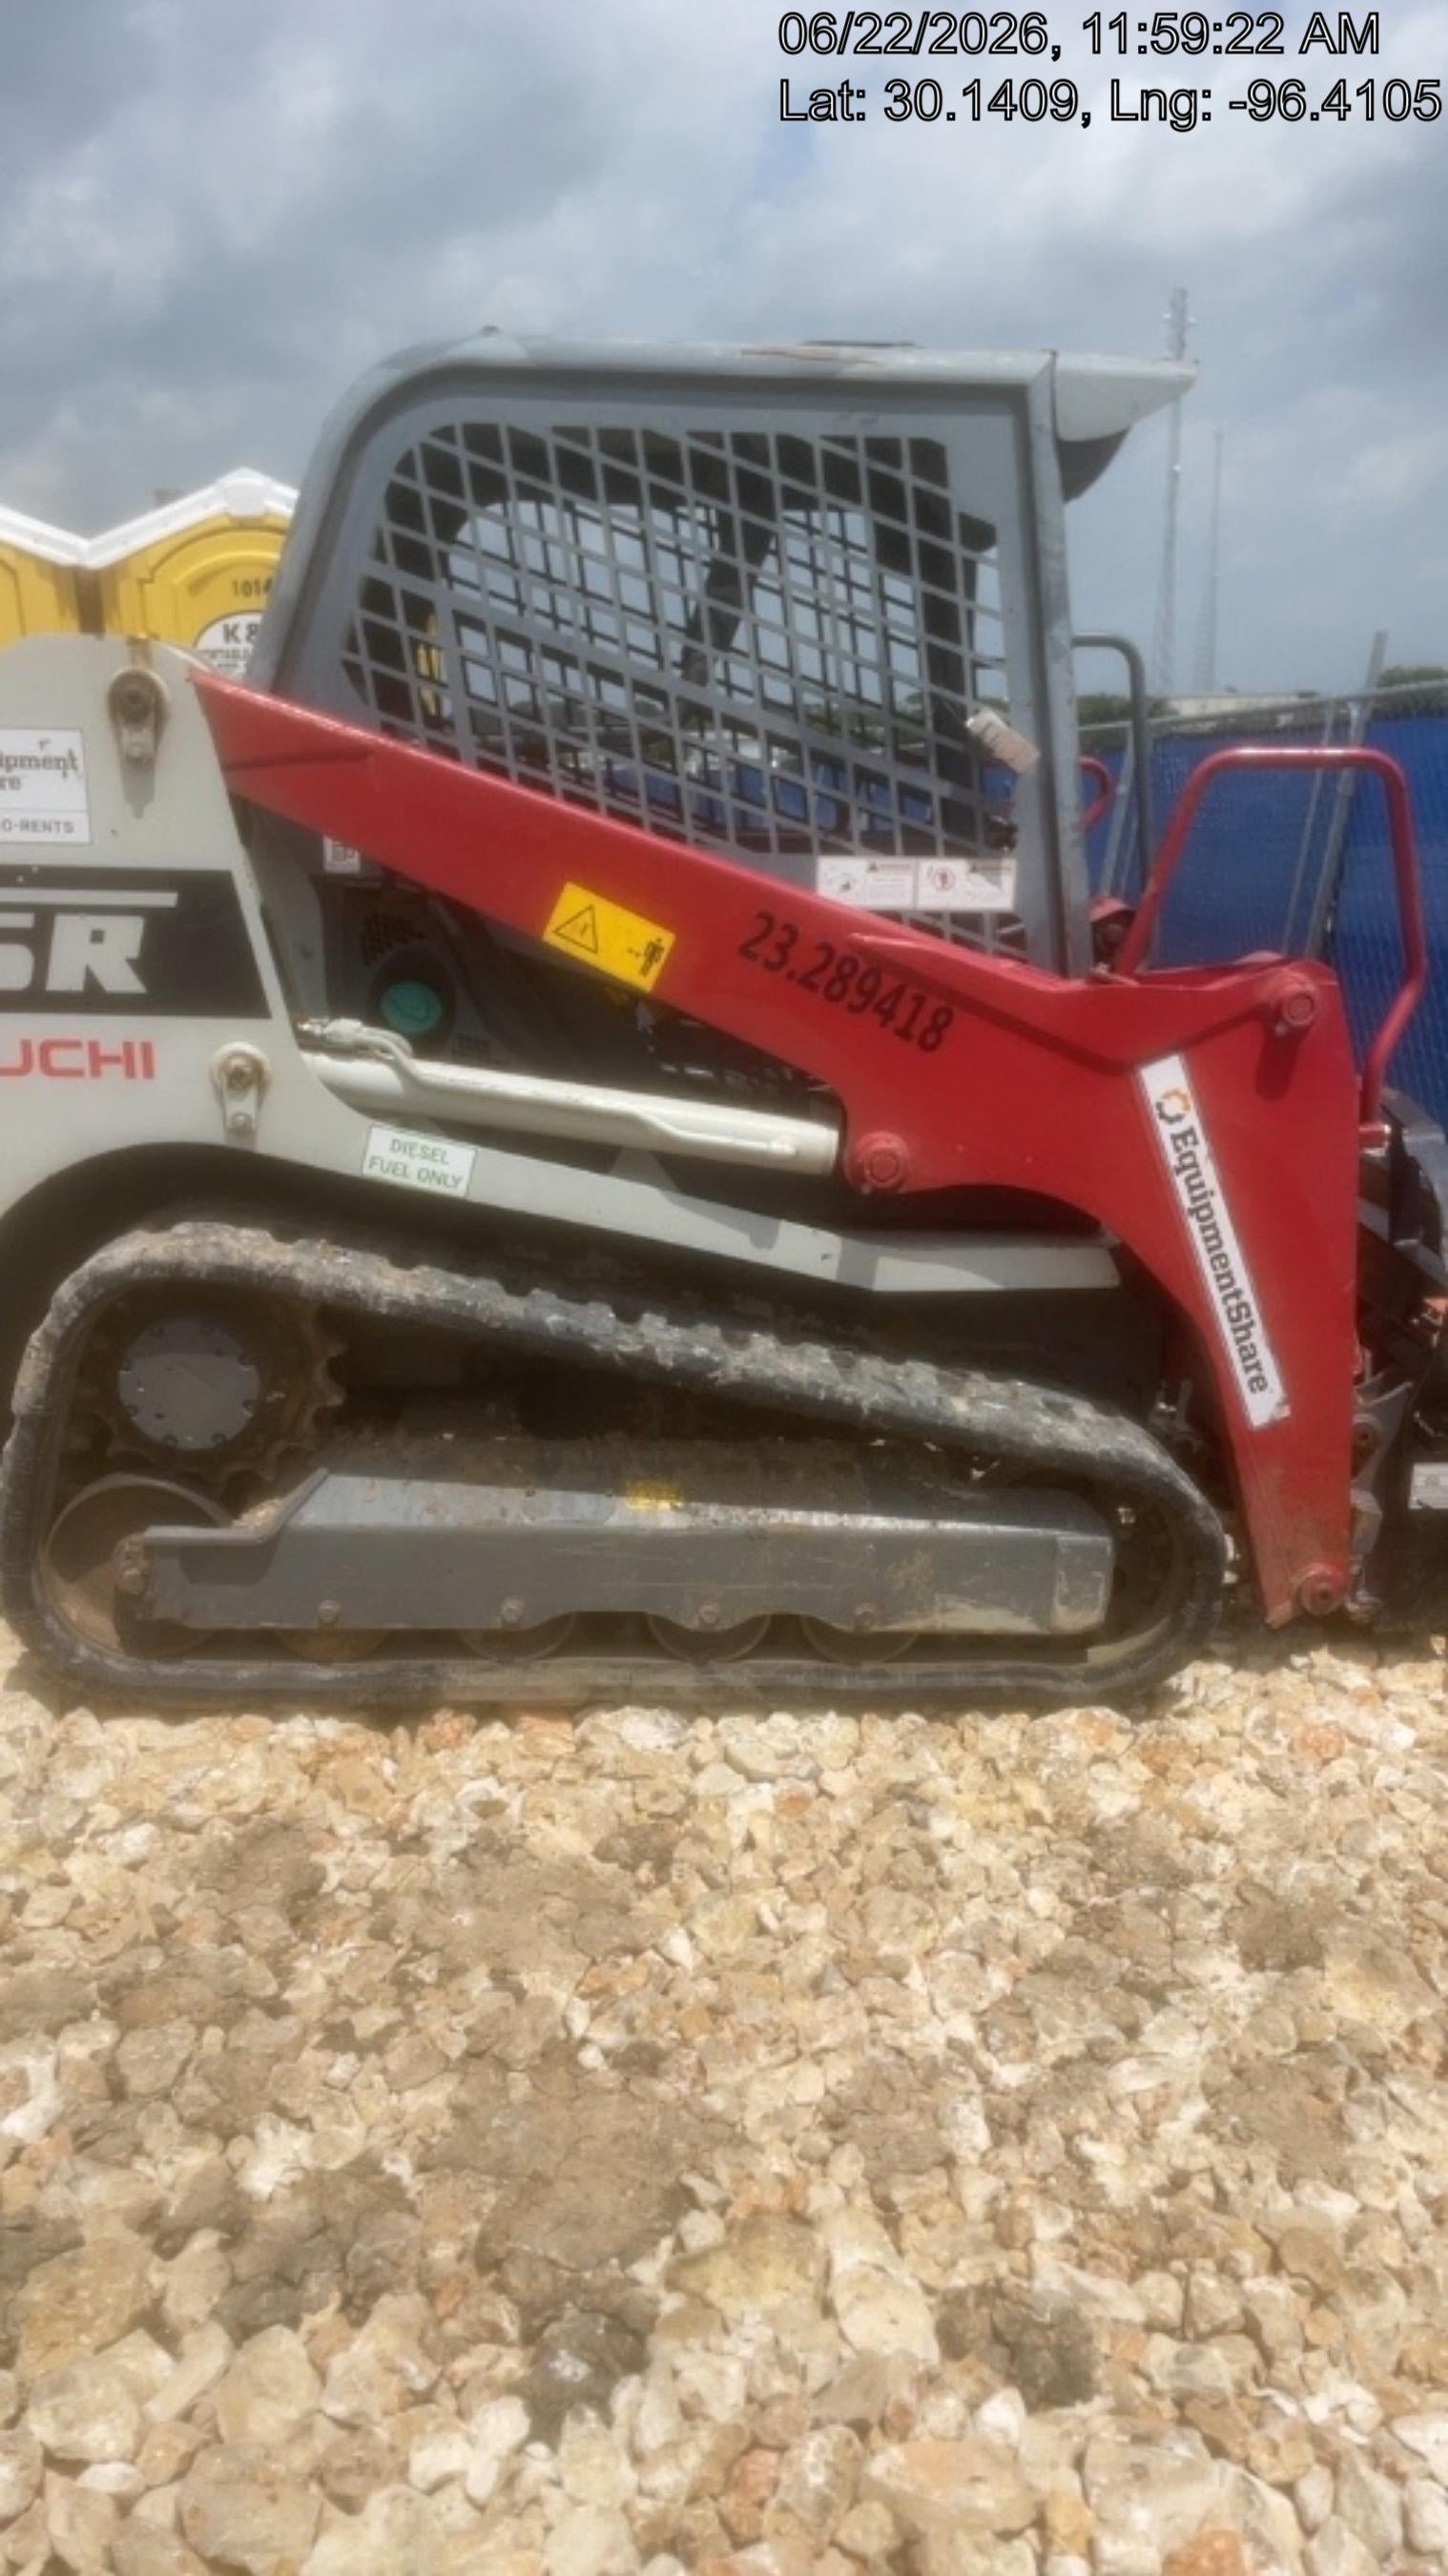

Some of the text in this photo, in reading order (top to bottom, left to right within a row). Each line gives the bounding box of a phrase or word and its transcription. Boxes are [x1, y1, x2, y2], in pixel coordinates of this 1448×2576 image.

[738, 910, 954, 1052] 23.289418
[369, 1155, 464, 1189] FUEL ONLY
[389, 1138, 450, 1166] DIESEL
[1169, 1125, 1269, 1395] EquipmentShare
